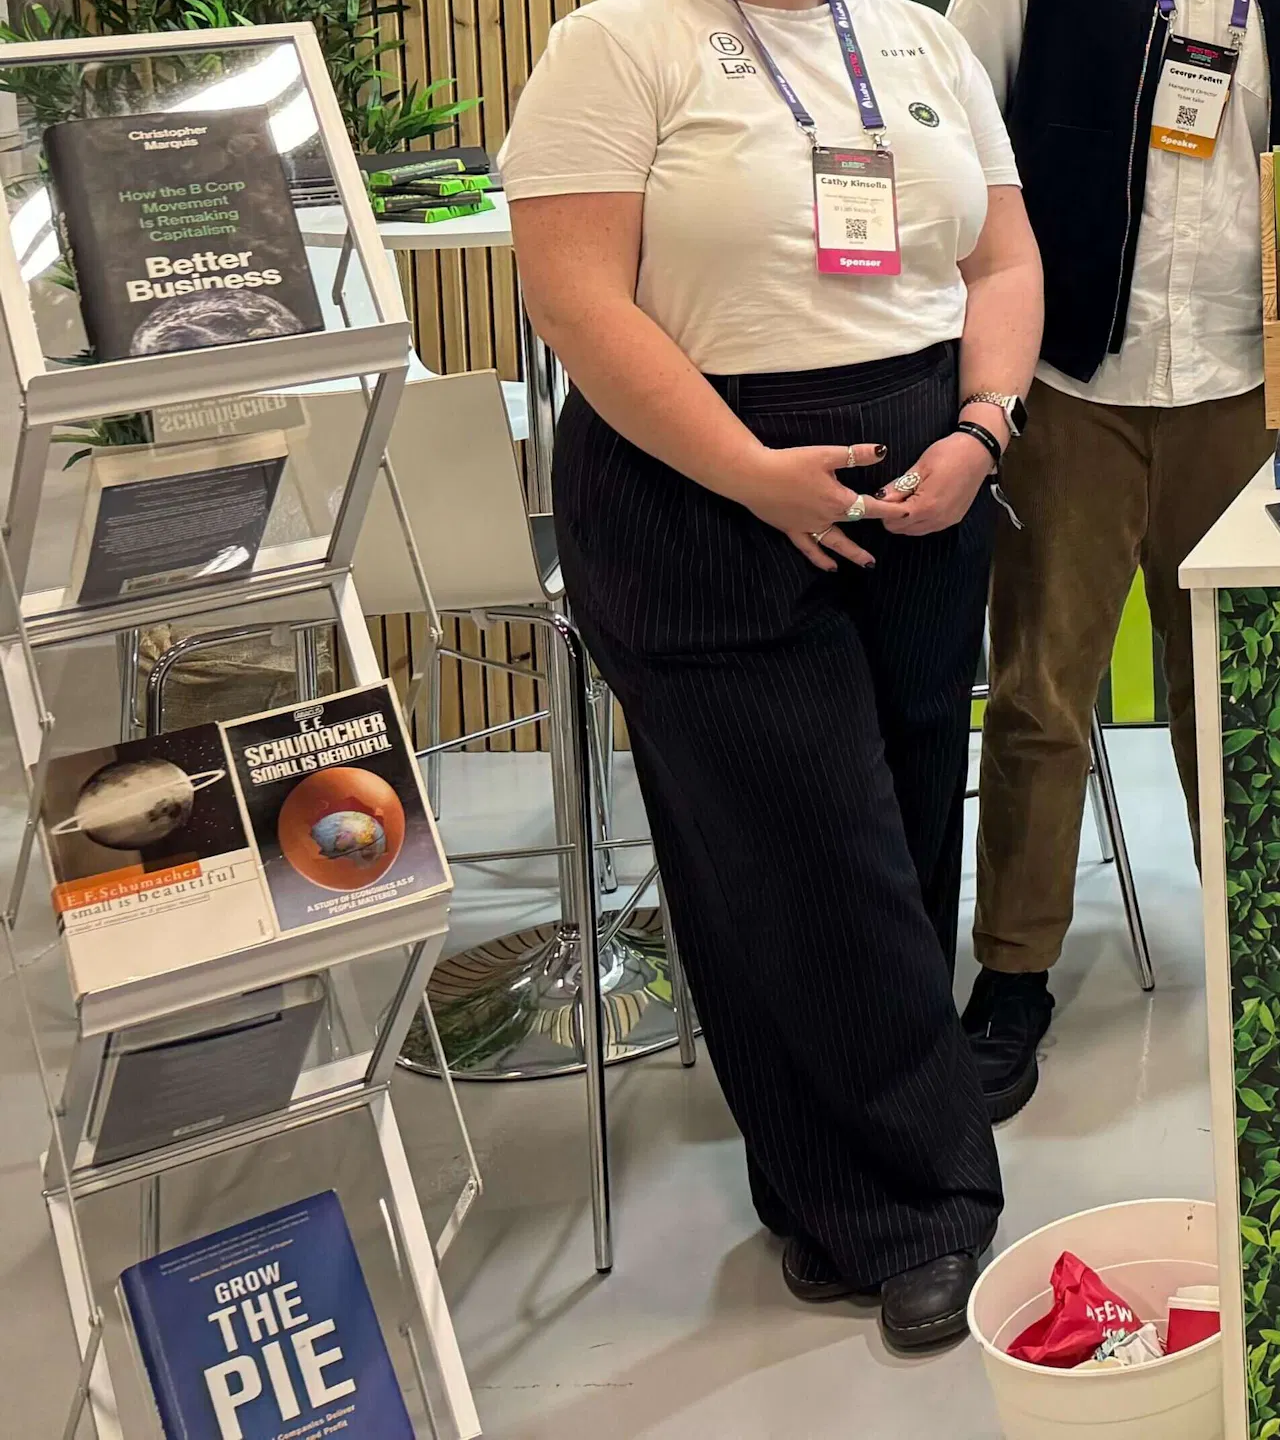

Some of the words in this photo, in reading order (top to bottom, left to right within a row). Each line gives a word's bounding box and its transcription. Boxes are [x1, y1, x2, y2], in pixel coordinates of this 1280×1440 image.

[721, 62, 756, 75] Lab
[128, 126, 208, 141] Christopher
[1161, 135, 1198, 150] Speaker
[144, 138, 198, 151] Marquis
[119, 190, 157, 203] How
[160, 187, 187, 199] the
[189, 184, 202, 195] B
[205, 181, 246, 194] Corp
[821, 177, 848, 188] Cathy
[142, 195, 230, 214] Movement
[139, 217, 154, 229] Is
[157, 209, 239, 228] Remaking
[150, 224, 237, 242] Capitalism
[145, 250, 253, 279] Better
[840, 258, 881, 267] Sponsor
[126, 268, 283, 302] Business
[244, 712, 387, 768] SCHUMACHER
[251, 760, 301, 785] SMALL
[301, 754, 318, 772] IS
[319, 734, 392, 768] BEAUTIFUL
[71, 901, 113, 921] small
[118, 899, 132, 910] is
[137, 866, 236, 904] beautiful
[306, 905, 313, 913] A
[314, 898, 339, 911] STUDY
[340, 895, 350, 905] OF
[350, 881, 396, 903] ECONOMICS
[396, 878, 407, 889] AS
[407, 875, 415, 885] IF
[328, 901, 358, 914] PEOPLE
[358, 889, 398, 909] MATTERED
[214, 1262, 281, 1304] GROW
[207, 1280, 309, 1353] THE
[204, 1318, 357, 1440] PIE
[325, 1404, 355, 1423] Deliver
[323, 1419, 348, 1436] Profit
